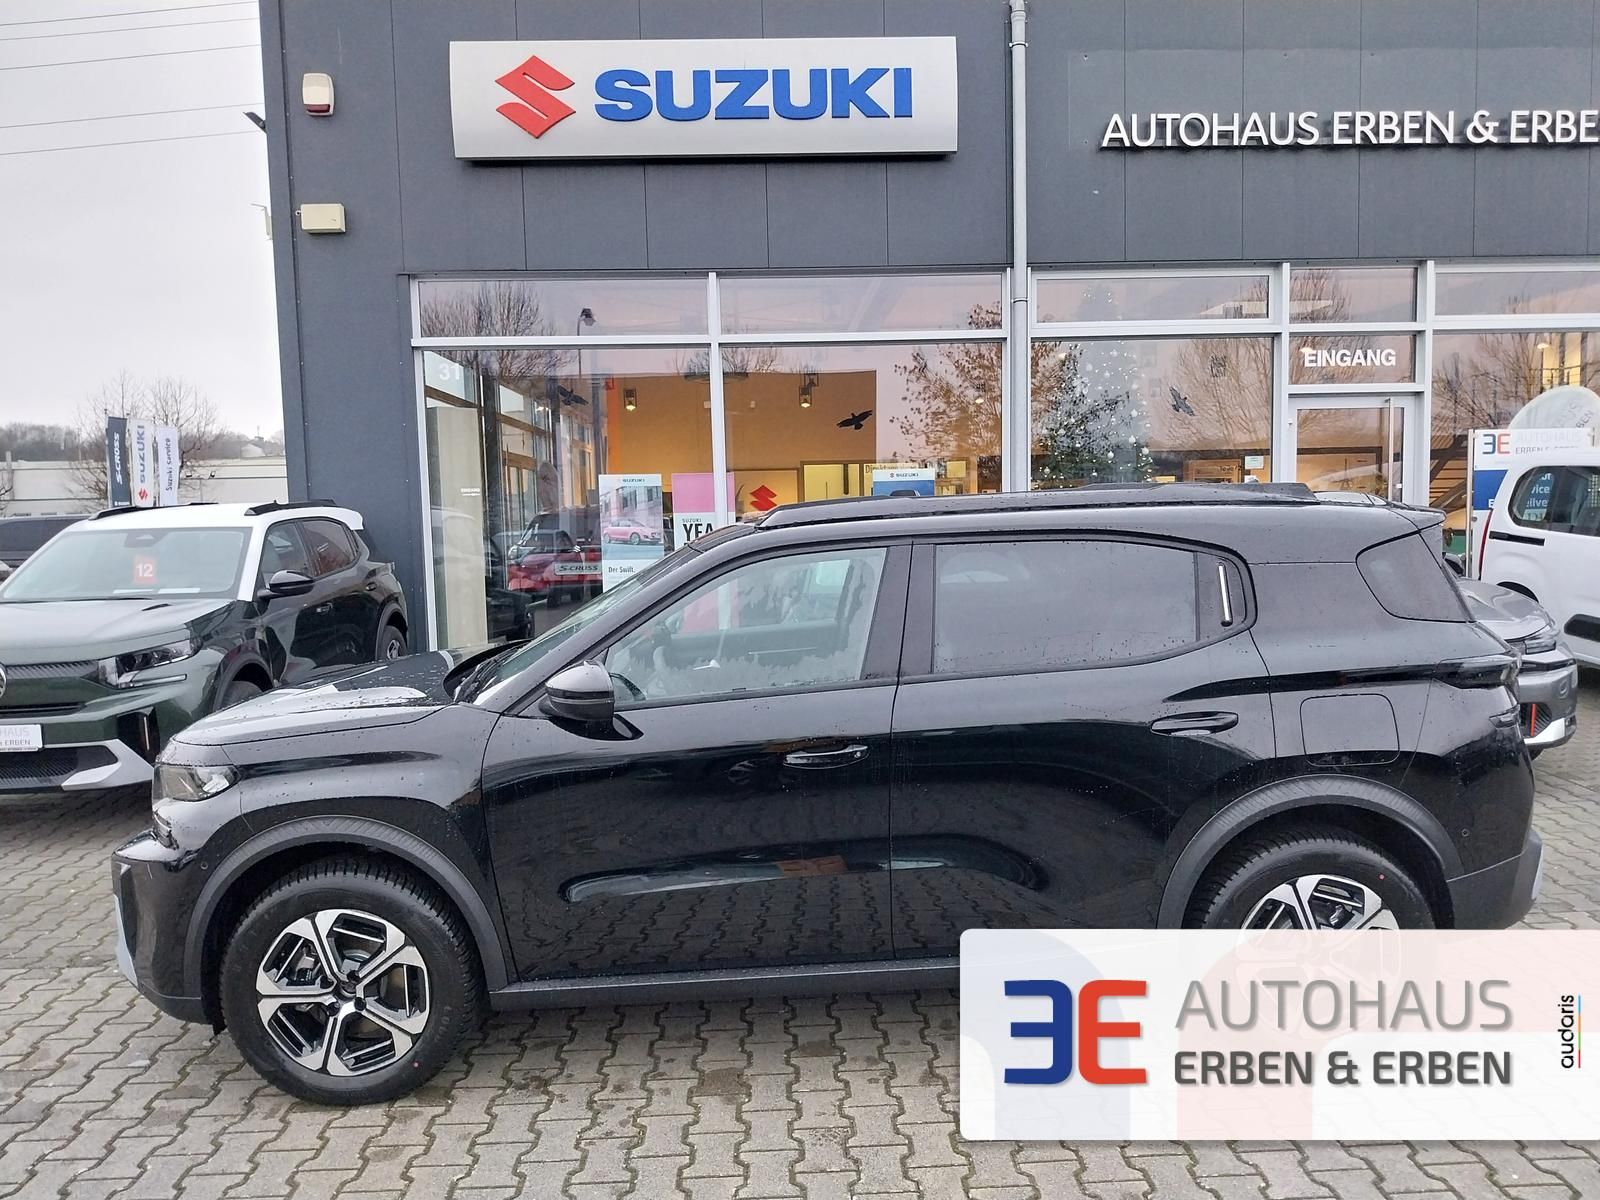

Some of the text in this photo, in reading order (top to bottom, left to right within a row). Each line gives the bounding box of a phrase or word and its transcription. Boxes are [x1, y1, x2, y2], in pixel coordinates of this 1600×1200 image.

[594, 67, 912, 122] SUZUKI
[1101, 112, 1320, 147] AUTOHAUS
[1332, 111, 1454, 145] ERBEN
[1466, 110, 1498, 143] &
[440, 363, 460, 380] 31
[1304, 349, 1396, 367] EINGANG
[136, 425, 146, 484] SUZUKI
[135, 563, 153, 577] 12
